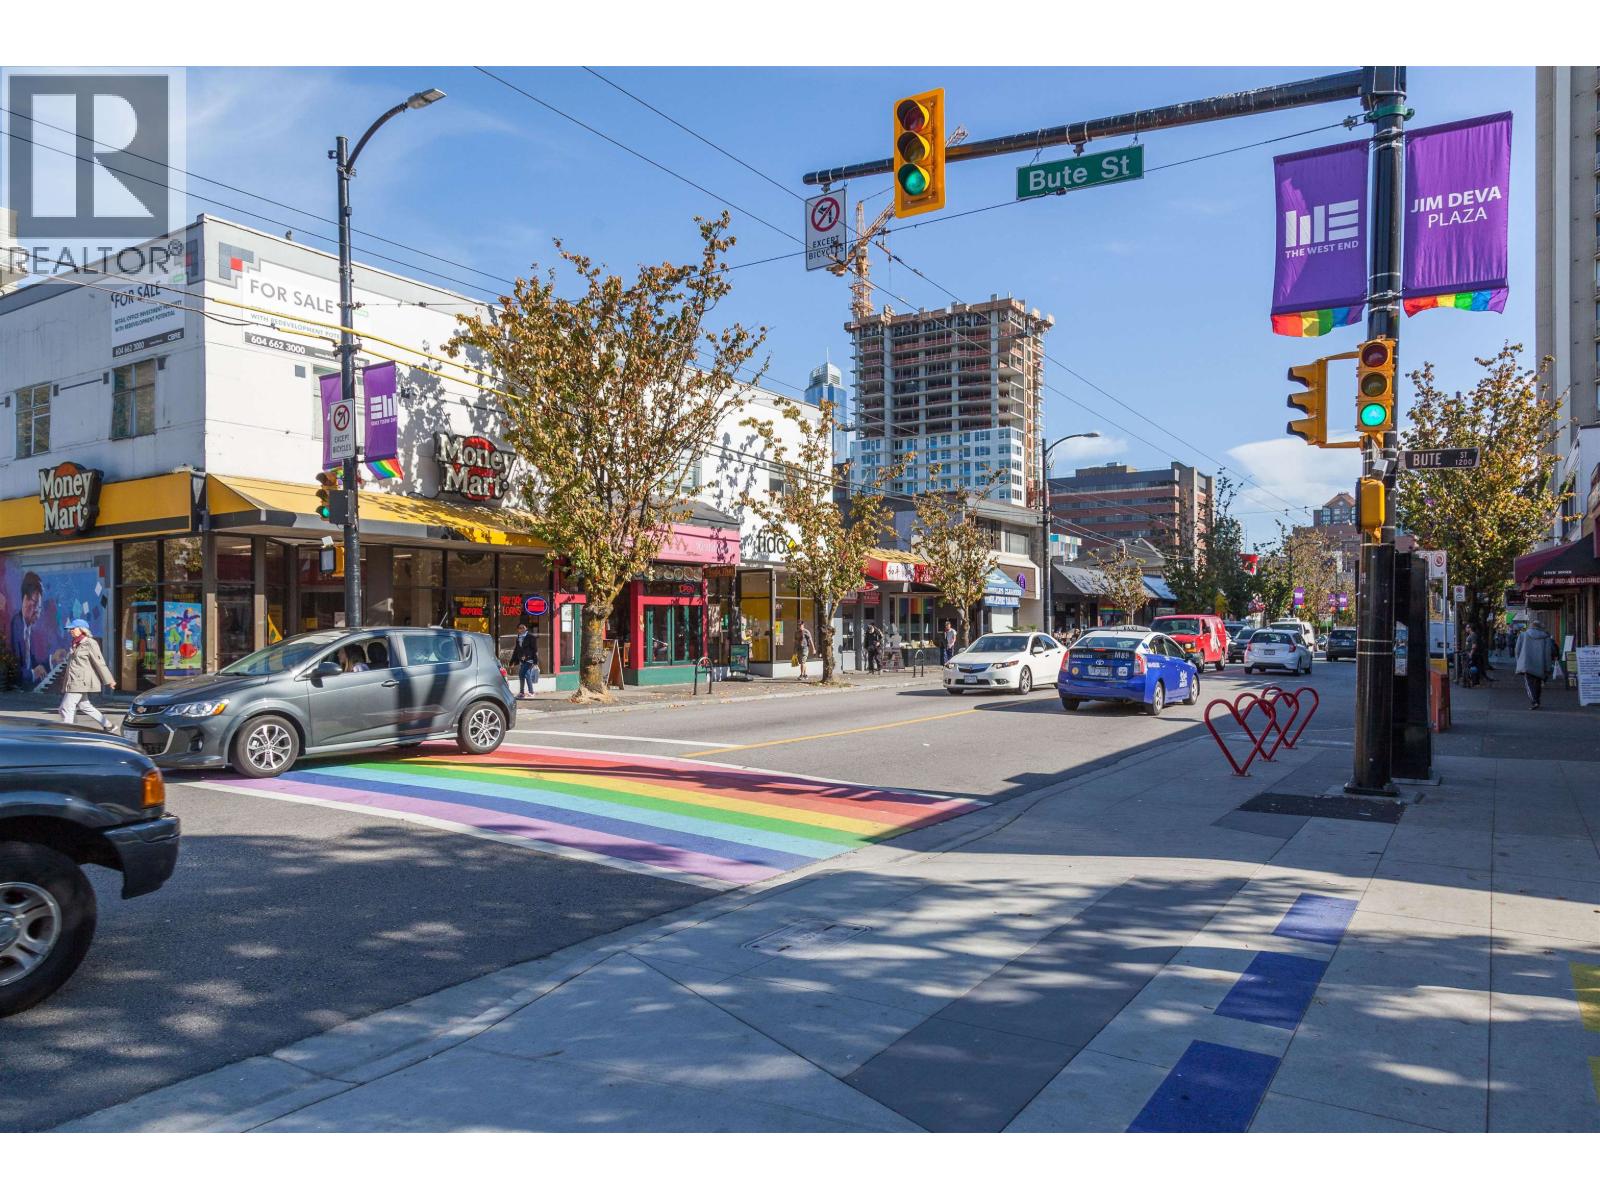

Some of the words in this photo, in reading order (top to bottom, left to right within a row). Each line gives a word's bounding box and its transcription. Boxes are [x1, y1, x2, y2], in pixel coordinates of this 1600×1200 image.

[1029, 165, 1088, 191] Bute
[1100, 155, 1130, 178] St
[1410, 194, 1443, 213] JIM
[1448, 186, 1502, 207] DEVA
[1428, 206, 1488, 228] PLAZA
[812, 234, 840, 248] EXCEPT
[1284, 249, 1305, 259] THE
[1306, 243, 1336, 254] WEST
[1337, 241, 1359, 251] END
[808, 245, 844, 260] BICYCLES
[114, 290, 134, 308] FOR
[137, 281, 160, 300] SALE
[250, 279, 287, 302] FOR
[293, 291, 334, 314] SALE
[250, 313, 269, 322] WITH
[251, 335, 268, 346] 604
[269, 340, 285, 350] 662
[286, 343, 306, 354] 3000
[332, 444, 351, 453] BICYCLES
[334, 435, 350, 443] EXCEPT
[438, 433, 516, 480] Money
[1412, 452, 1442, 466] BUTE
[39, 470, 92, 504] Money
[444, 463, 505, 498] Mart
[44, 501, 85, 530] Mart
[757, 528, 786, 554] fido
[502, 606, 521, 616] LOANS
